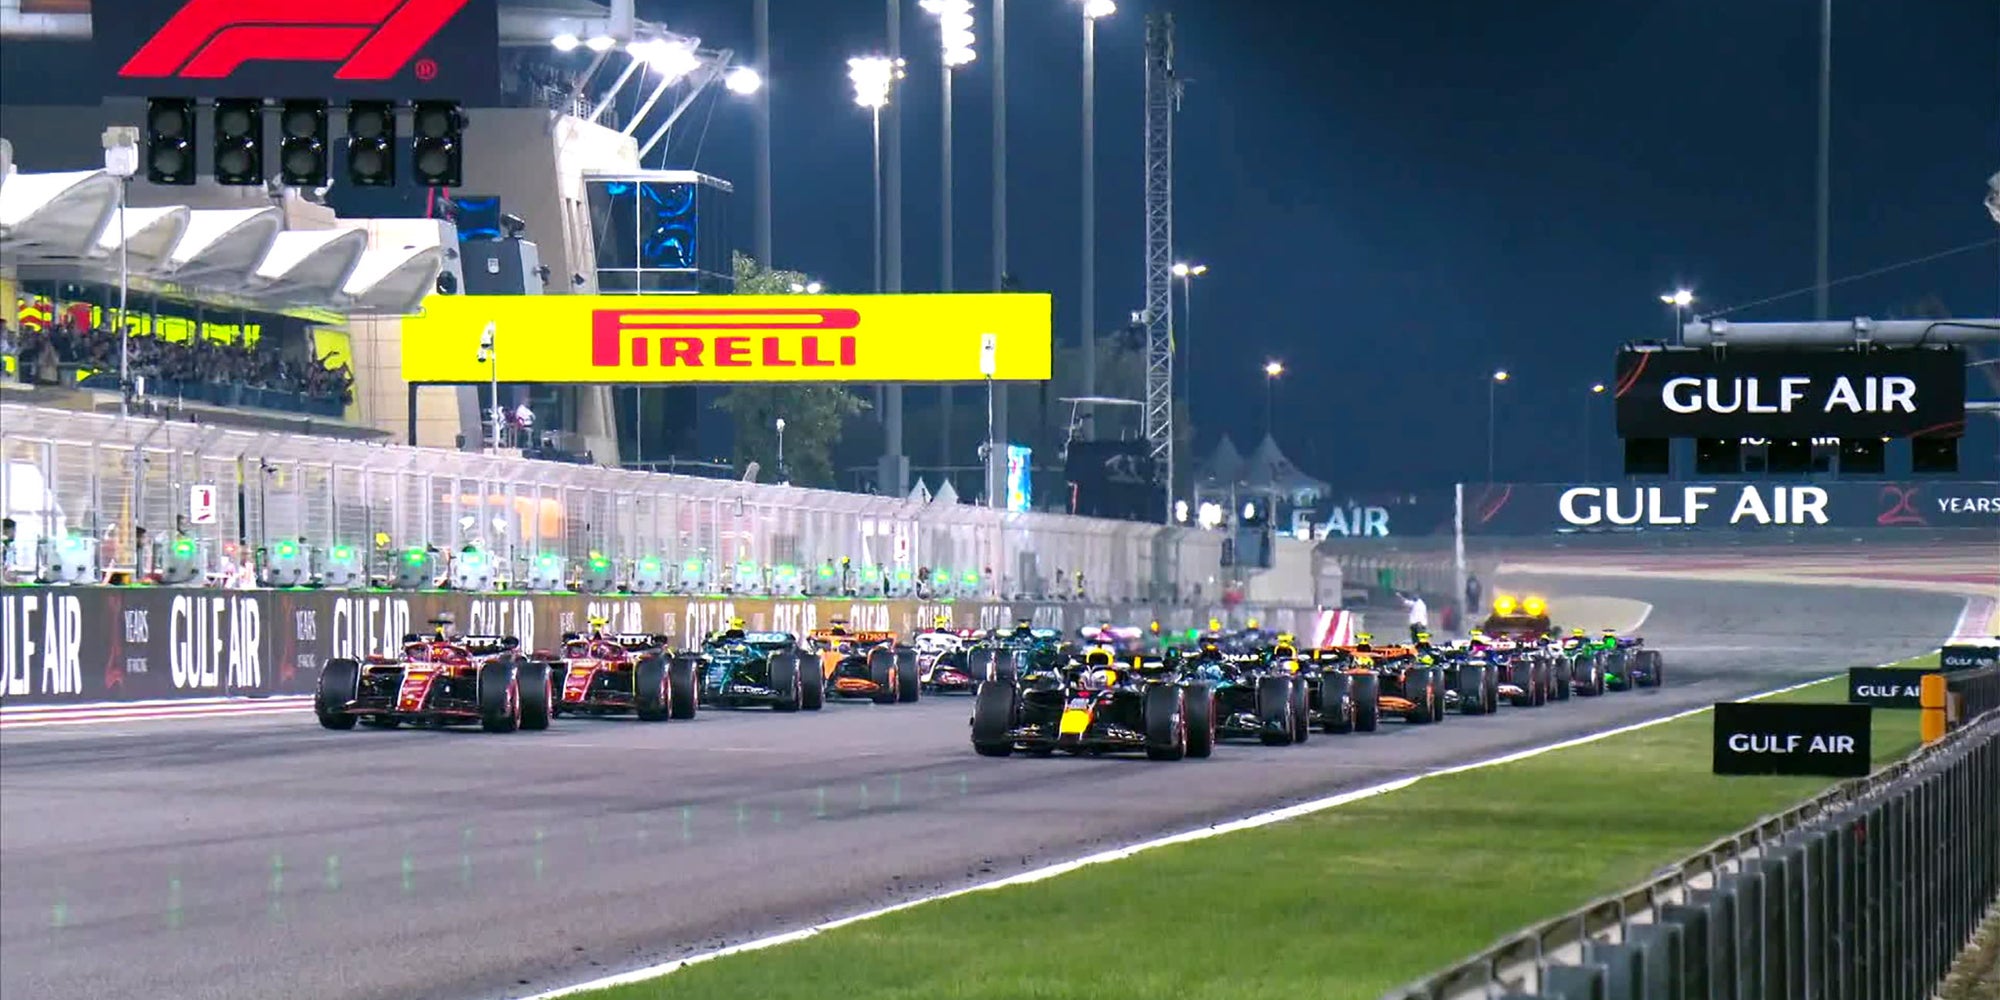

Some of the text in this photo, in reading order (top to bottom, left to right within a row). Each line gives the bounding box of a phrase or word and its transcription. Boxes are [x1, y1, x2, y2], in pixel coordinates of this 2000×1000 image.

[591, 307, 861, 367] PIRELLI
[1661, 376, 1917, 413] GULF AIR
[1326, 506, 1390, 537] AIR
[1558, 486, 1830, 525] GULF AIR
[1938, 498, 2000, 513] YEARS
[42, 592, 82, 695] AIR
[170, 594, 261, 689] GULF AIR
[1857, 685, 1920, 697] GULF AI
[1728, 733, 1855, 754] GULF AIR
